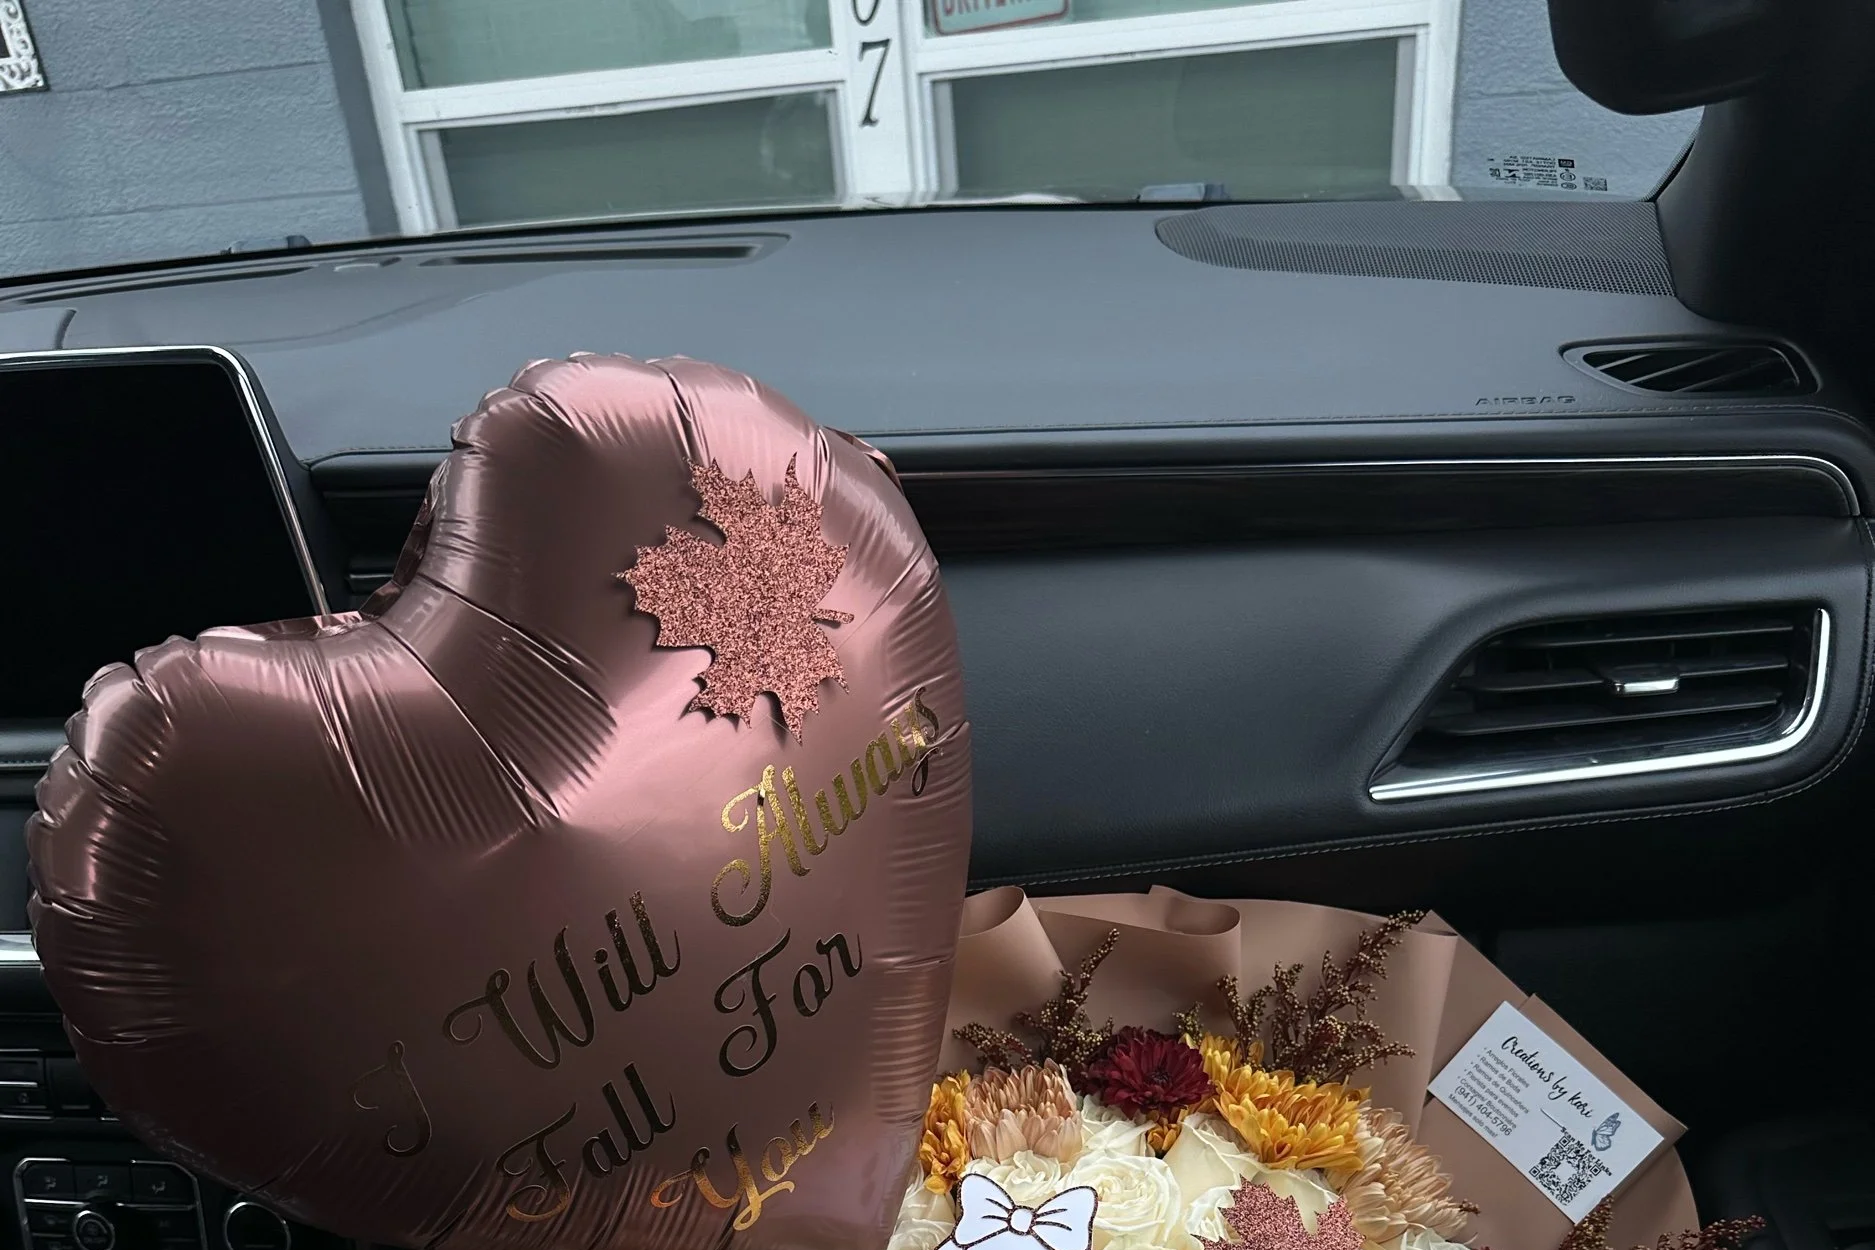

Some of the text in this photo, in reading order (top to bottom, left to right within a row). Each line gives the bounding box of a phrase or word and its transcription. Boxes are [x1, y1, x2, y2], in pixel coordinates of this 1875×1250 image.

[1474, 395, 1577, 406] AIRBAG
[442, 890, 681, 1070] Will
[710, 686, 940, 927] Always
[495, 927, 863, 1222] Fall For
[1472, 1063, 1492, 1082] Ramos
[1479, 1055, 1499, 1074] Ramos
[1505, 1078, 1520, 1093] Boda
[1500, 1035, 1554, 1082] Creations
[1547, 1075, 1567, 1100] by
[1454, 1085, 1512, 1136] (941) 404-5796
[649, 1101, 835, 1231] You
[1560, 1126, 1575, 1142] Scan
[1592, 1158, 1612, 1176] Links
